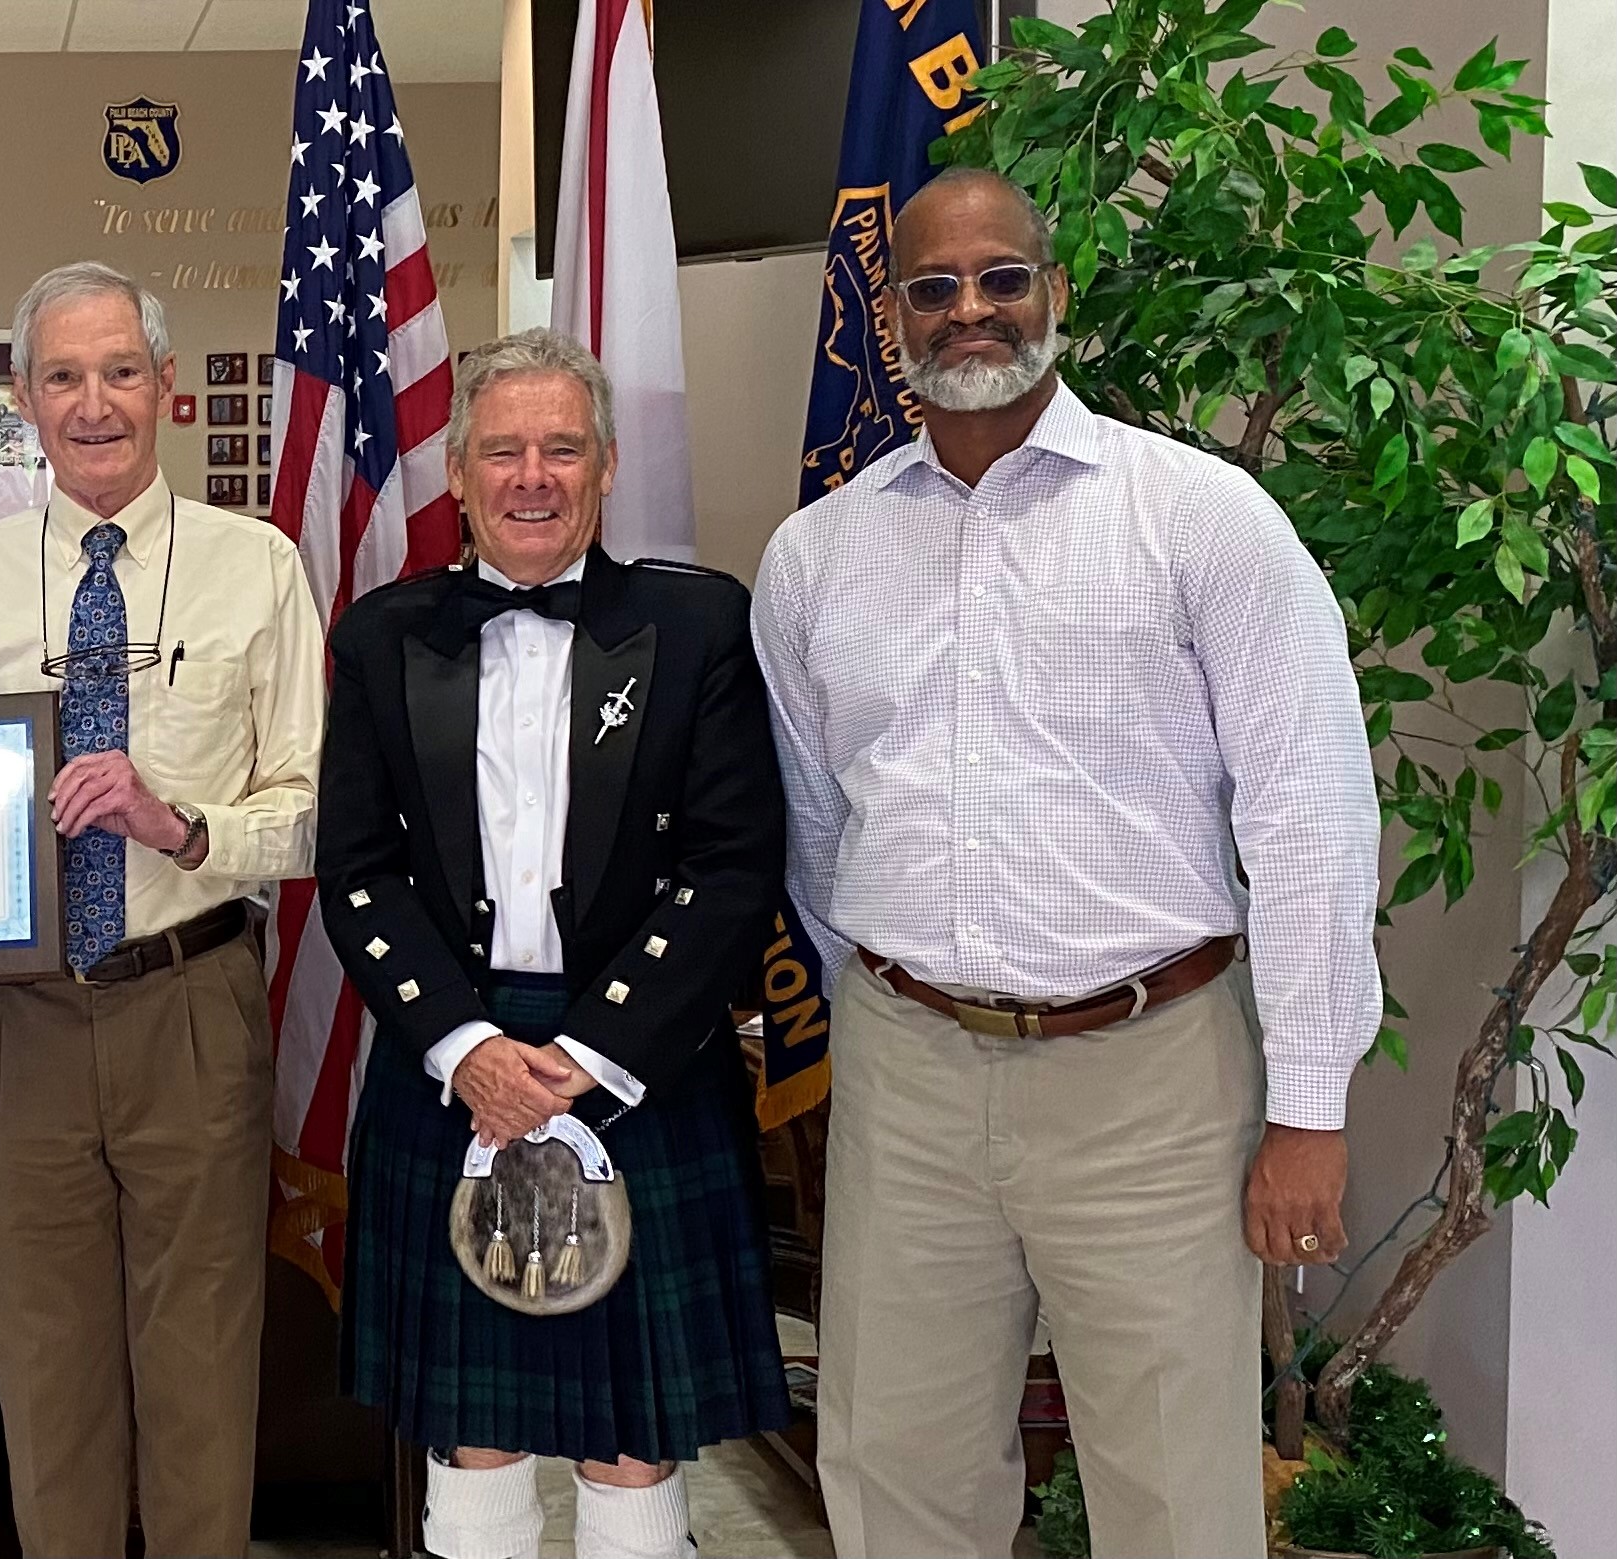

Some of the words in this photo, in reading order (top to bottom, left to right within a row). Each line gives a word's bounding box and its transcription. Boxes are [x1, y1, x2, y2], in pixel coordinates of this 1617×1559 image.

[149, 108, 174, 117] COUNTY
[143, 208, 215, 233] serve
[843, 206, 886, 293] PALM
